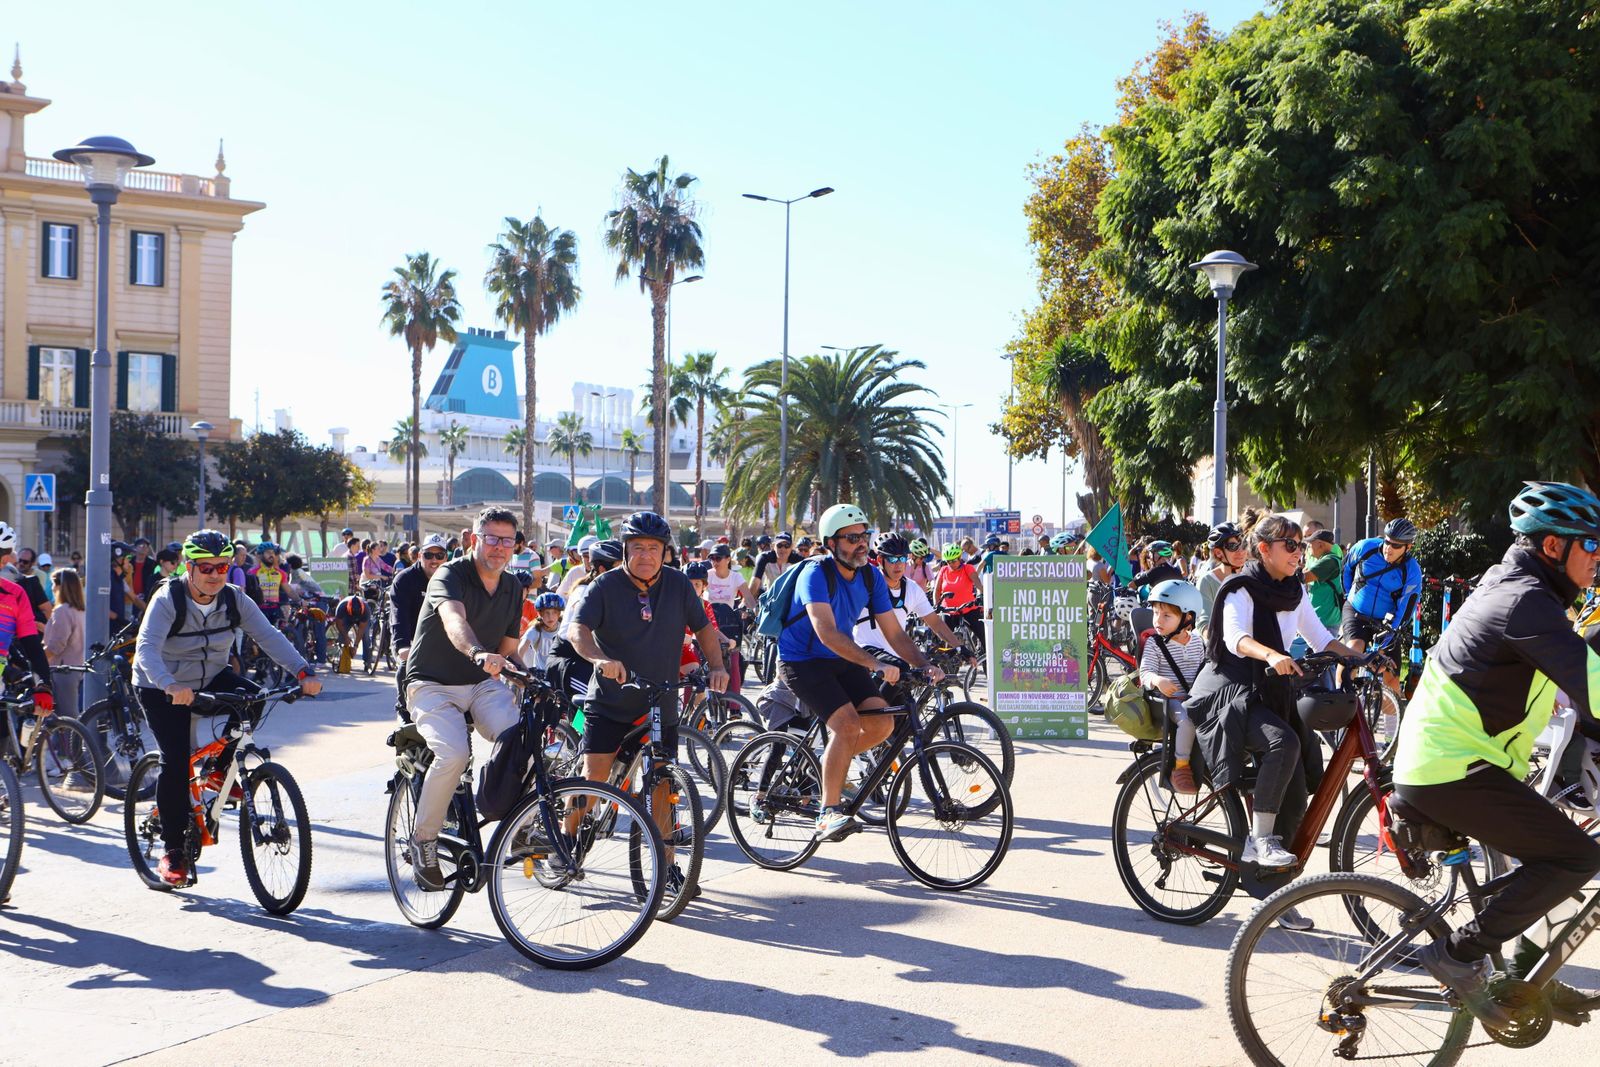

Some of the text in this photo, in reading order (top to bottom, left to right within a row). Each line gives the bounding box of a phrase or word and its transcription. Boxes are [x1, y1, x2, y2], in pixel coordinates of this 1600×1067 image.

[489, 369, 497, 389] B
[997, 560, 1084, 578] BICIFESTACIÓN
[1013, 589, 1069, 605] ¡NO HAY
[999, 606, 1084, 623] TIEMPO QUE
[1011, 623, 1071, 640] PERDER!
[1014, 659, 1068, 667] SOSTENIBLE
[1015, 652, 1063, 660] MOVILIDAD
